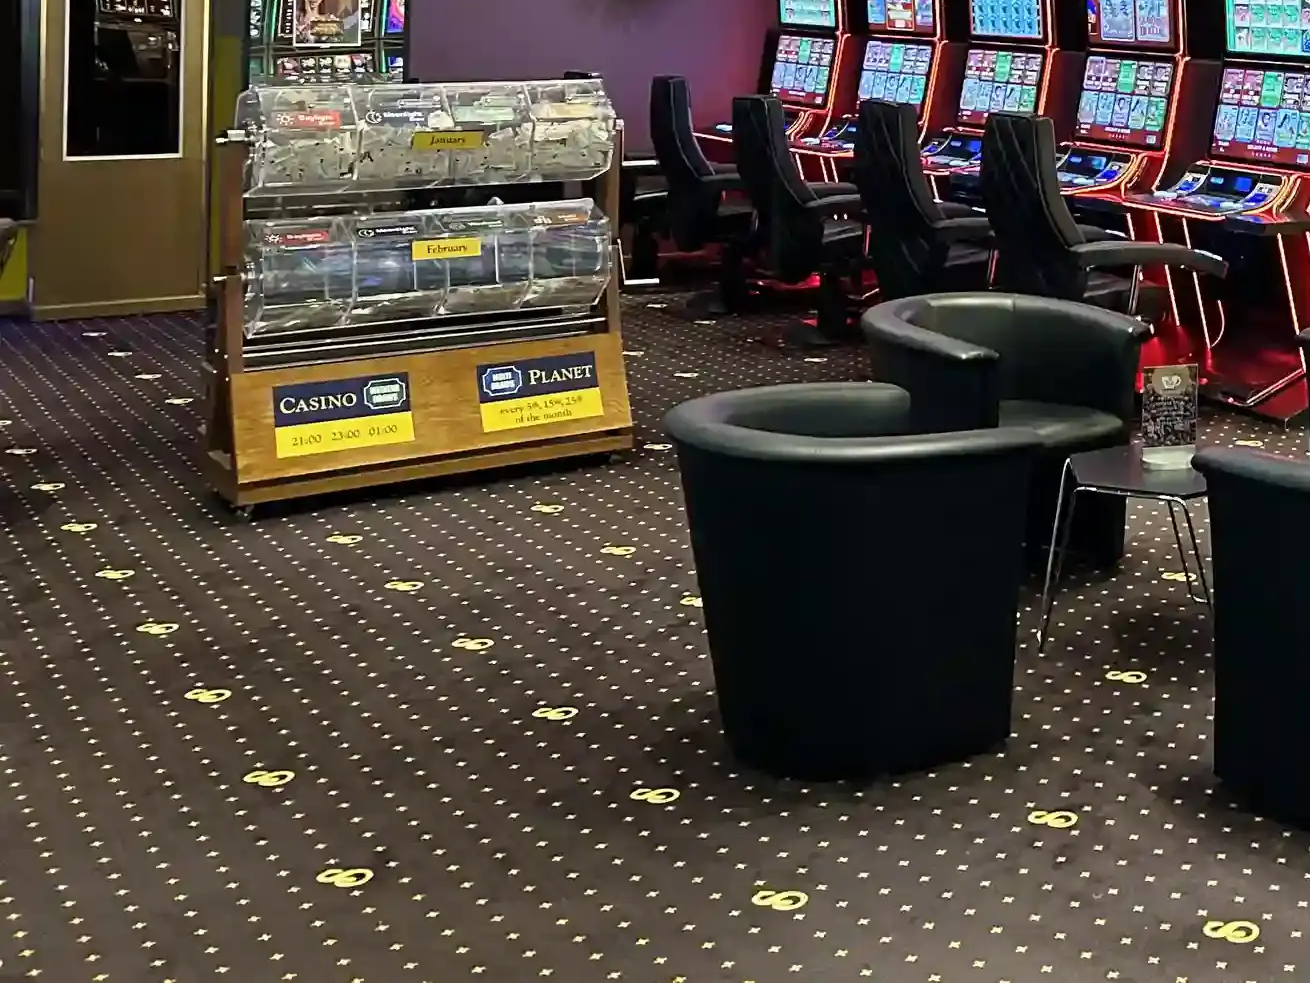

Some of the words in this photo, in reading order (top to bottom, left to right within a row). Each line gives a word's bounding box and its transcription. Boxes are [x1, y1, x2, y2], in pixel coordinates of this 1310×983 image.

[426, 243, 468, 255] February
[527, 364, 593, 386] PLANET
[279, 392, 357, 415] CASINO
[526, 412, 541, 423] the
[543, 408, 573, 421] month
